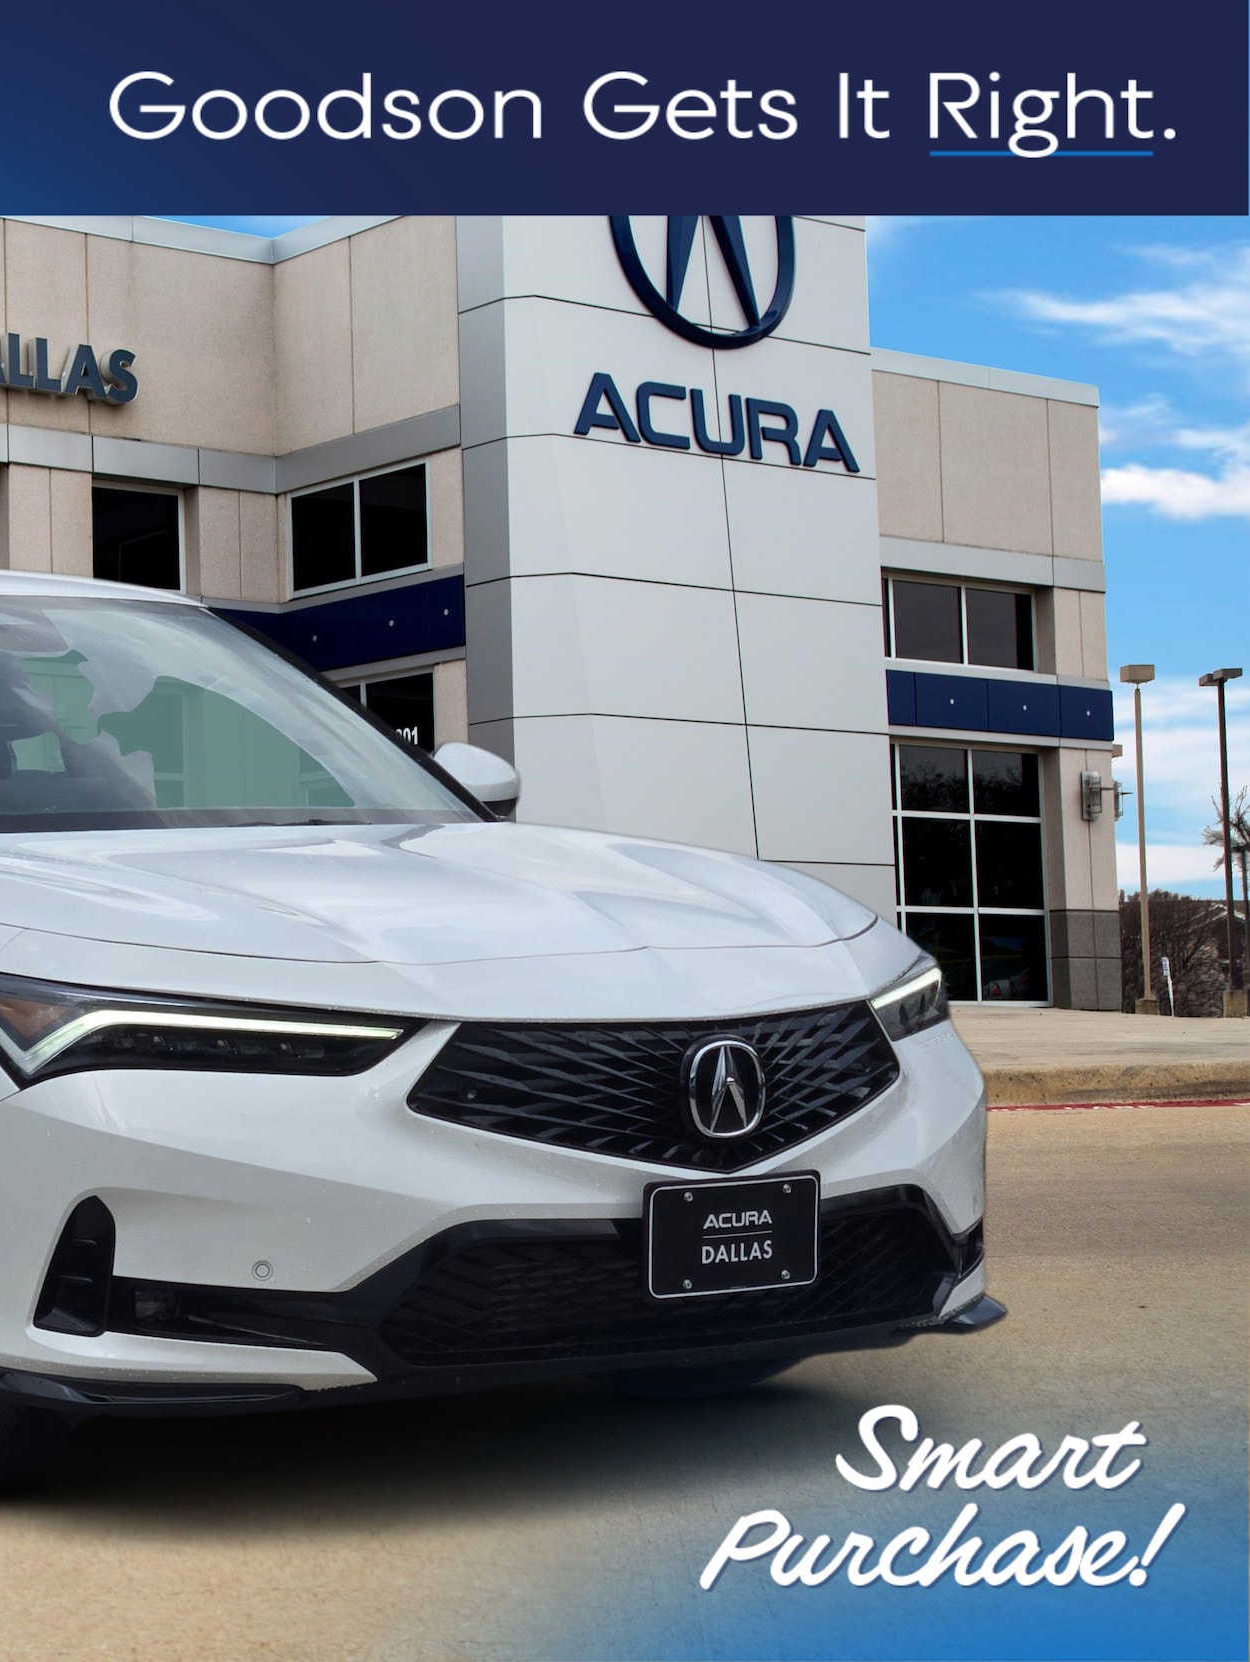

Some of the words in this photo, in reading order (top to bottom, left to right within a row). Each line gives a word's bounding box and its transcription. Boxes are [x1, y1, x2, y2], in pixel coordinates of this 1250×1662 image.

[574, 372, 860, 473] ACURA
[703, 1209, 772, 1229] ACURA
[701, 1239, 773, 1264] DALLAS
